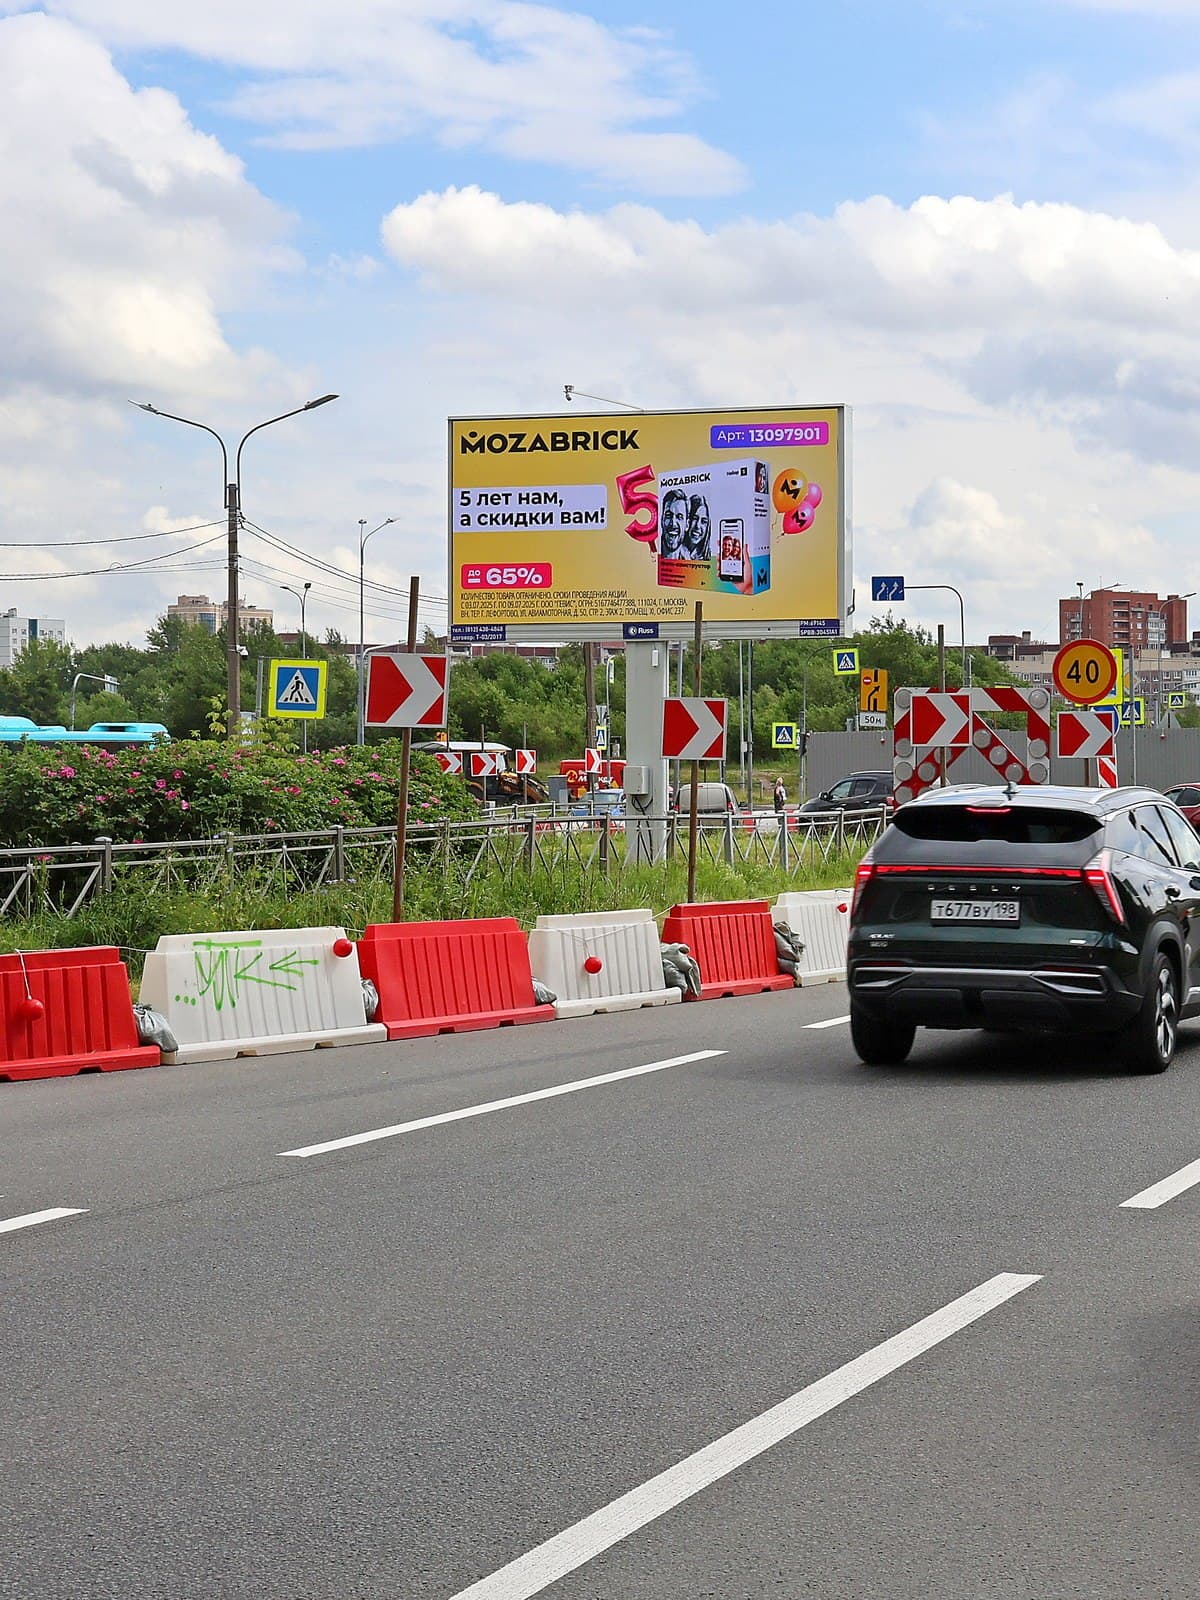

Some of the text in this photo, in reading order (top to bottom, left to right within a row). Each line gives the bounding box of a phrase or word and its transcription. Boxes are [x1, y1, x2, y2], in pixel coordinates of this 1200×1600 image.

[461, 430, 640, 454] MOZABRICK
[717, 427, 820, 443] Арт: 13097901
[460, 490, 564, 508] 5 лет нам,
[460, 507, 605, 527] а скидки вам!
[468, 567, 543, 585] до 65%
[1066, 659, 1100, 684] 40
[993, 903, 1015, 915] 198
